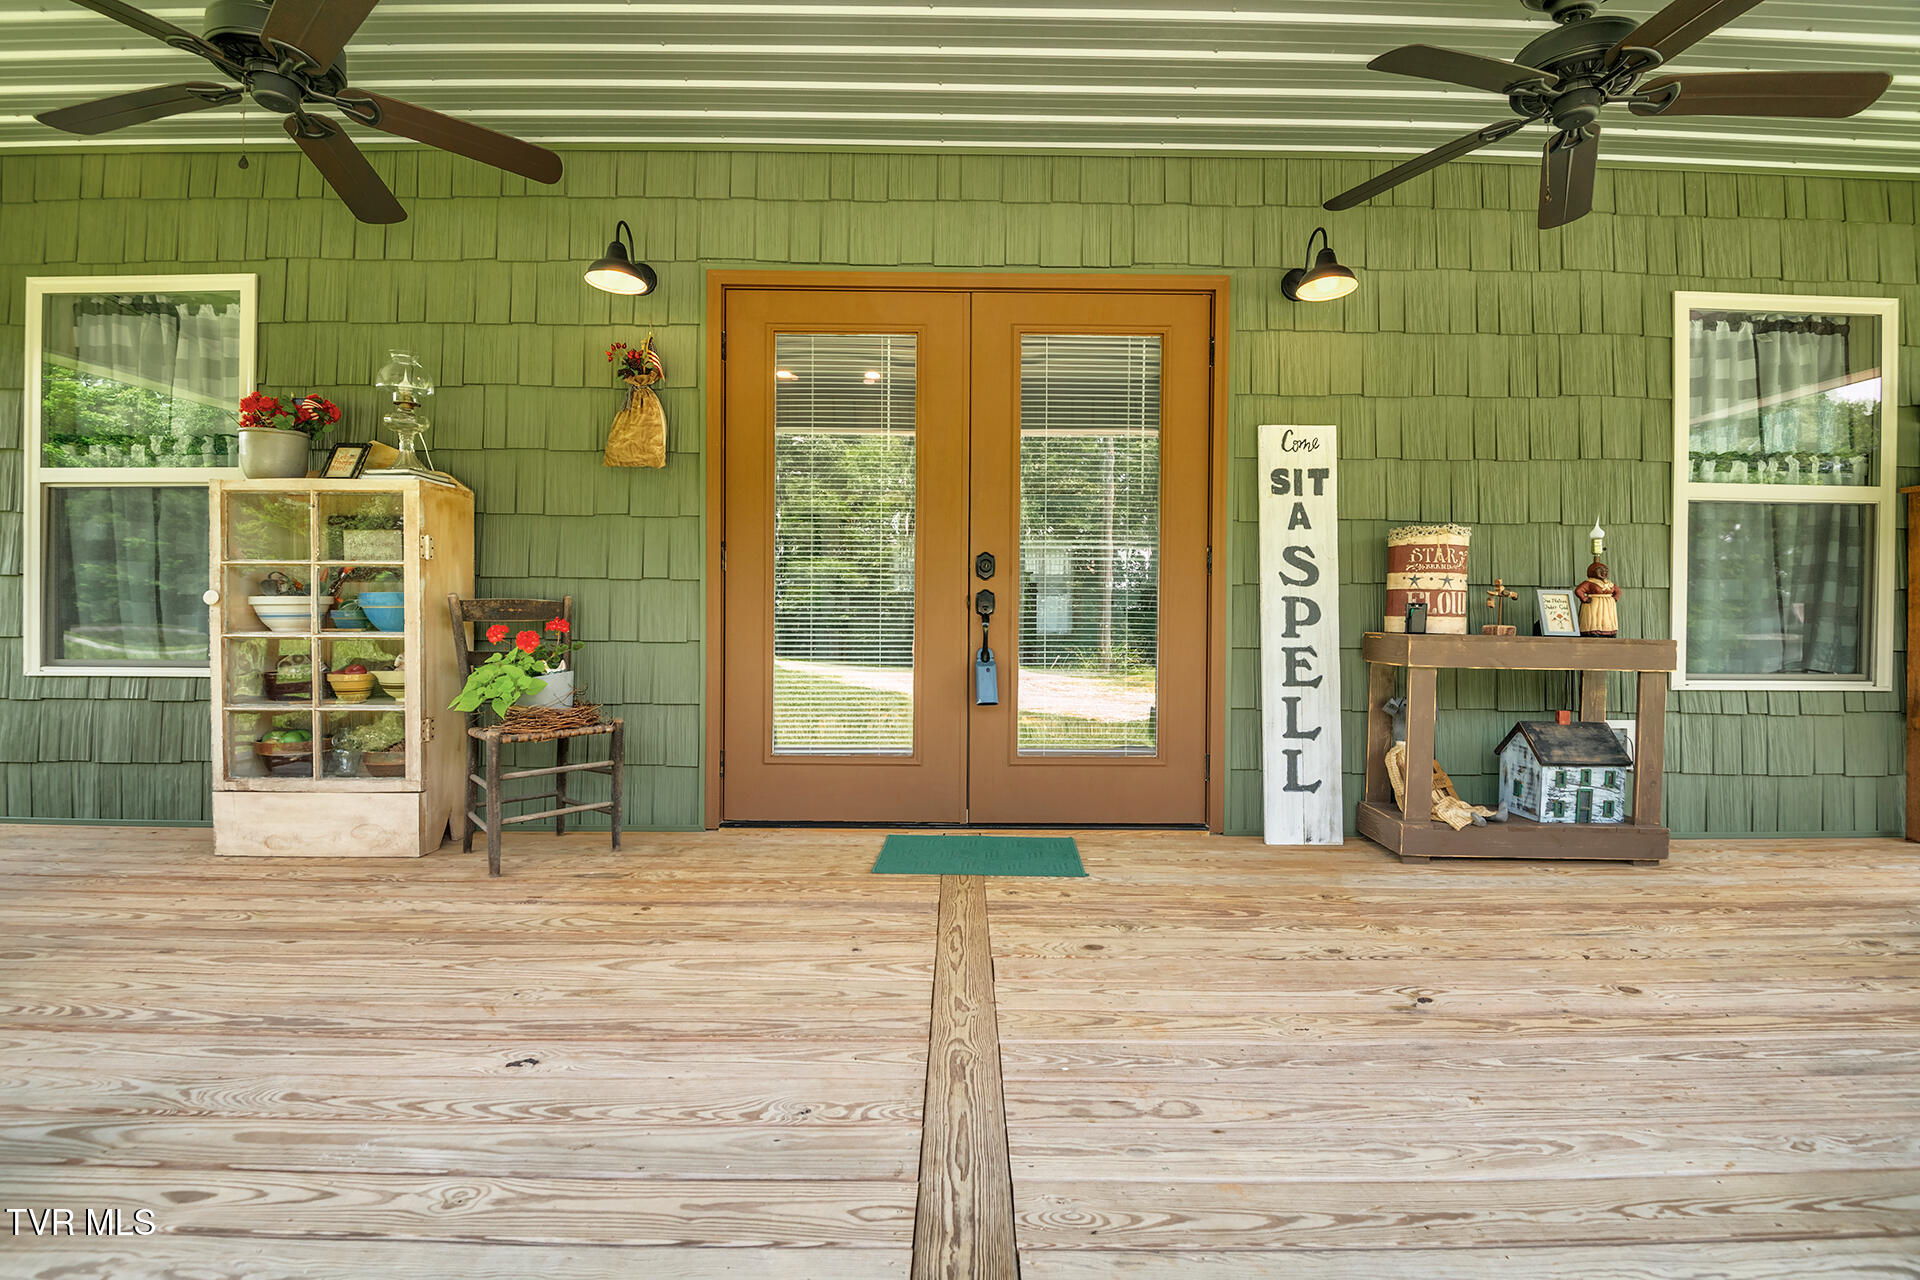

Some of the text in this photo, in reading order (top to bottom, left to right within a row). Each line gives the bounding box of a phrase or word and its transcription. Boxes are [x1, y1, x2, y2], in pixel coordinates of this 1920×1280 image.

[1281, 429, 1320, 452] Come
[1271, 468, 1330, 496] SIT
[1288, 502, 1312, 530] A
[1409, 547, 1458, 563] STAR
[1279, 545, 1323, 794] SPELL
